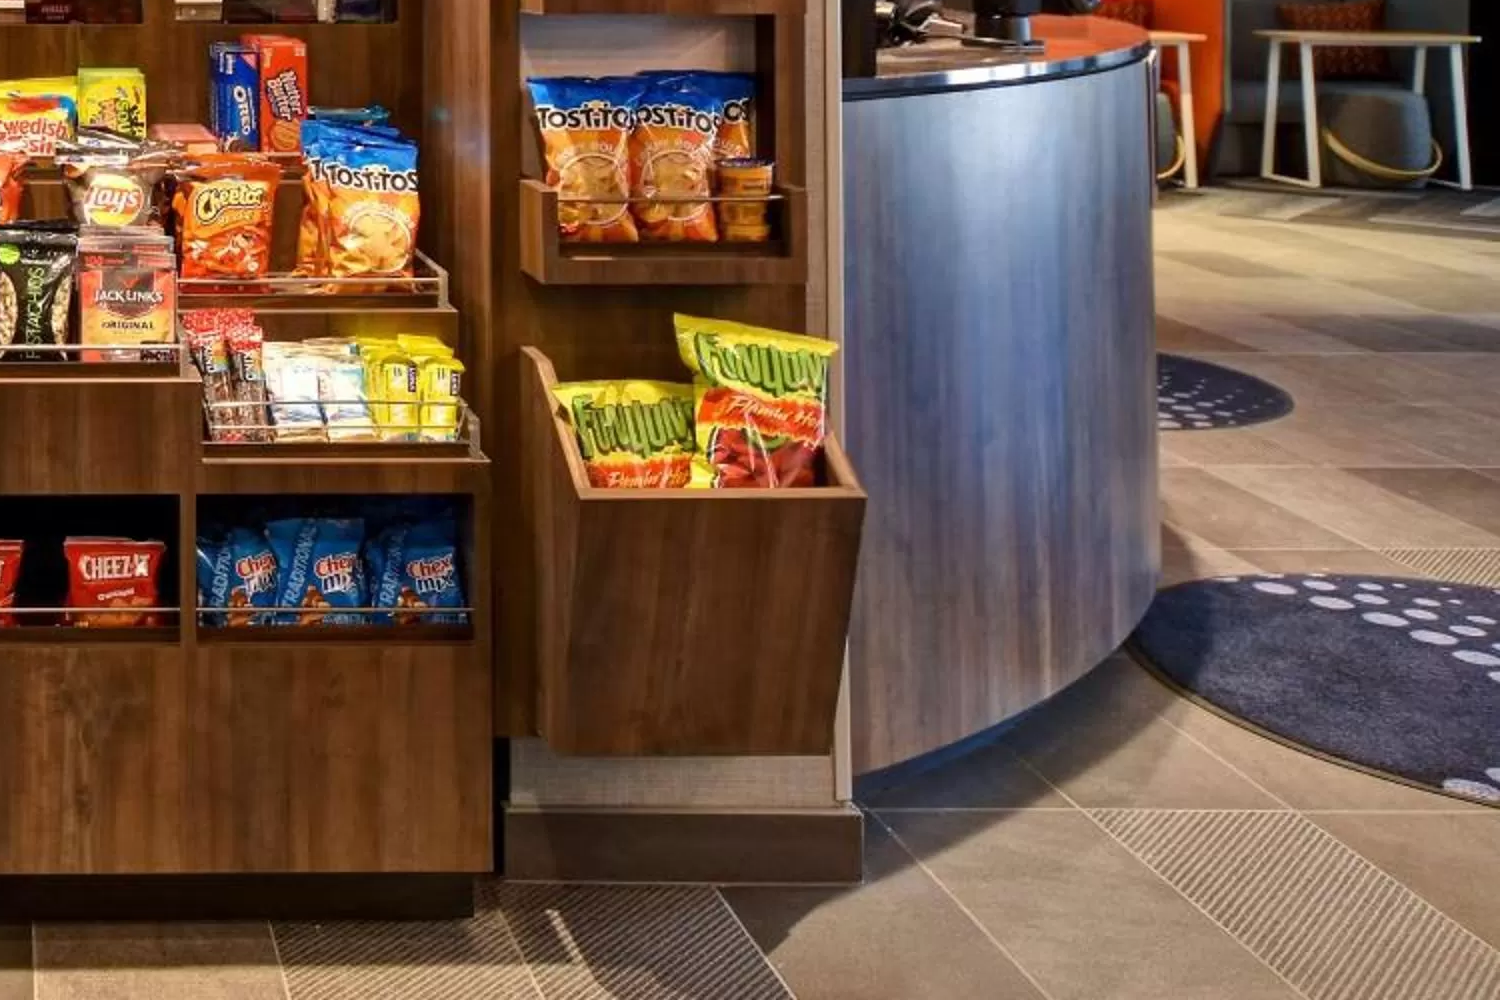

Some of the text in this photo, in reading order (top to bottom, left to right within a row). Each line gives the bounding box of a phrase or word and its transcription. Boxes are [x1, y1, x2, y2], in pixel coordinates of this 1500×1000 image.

[233, 85, 251, 135] OREO
[26, 267, 45, 359] PSTACHIOS
[101, 321, 155, 329] ORIGINAL
